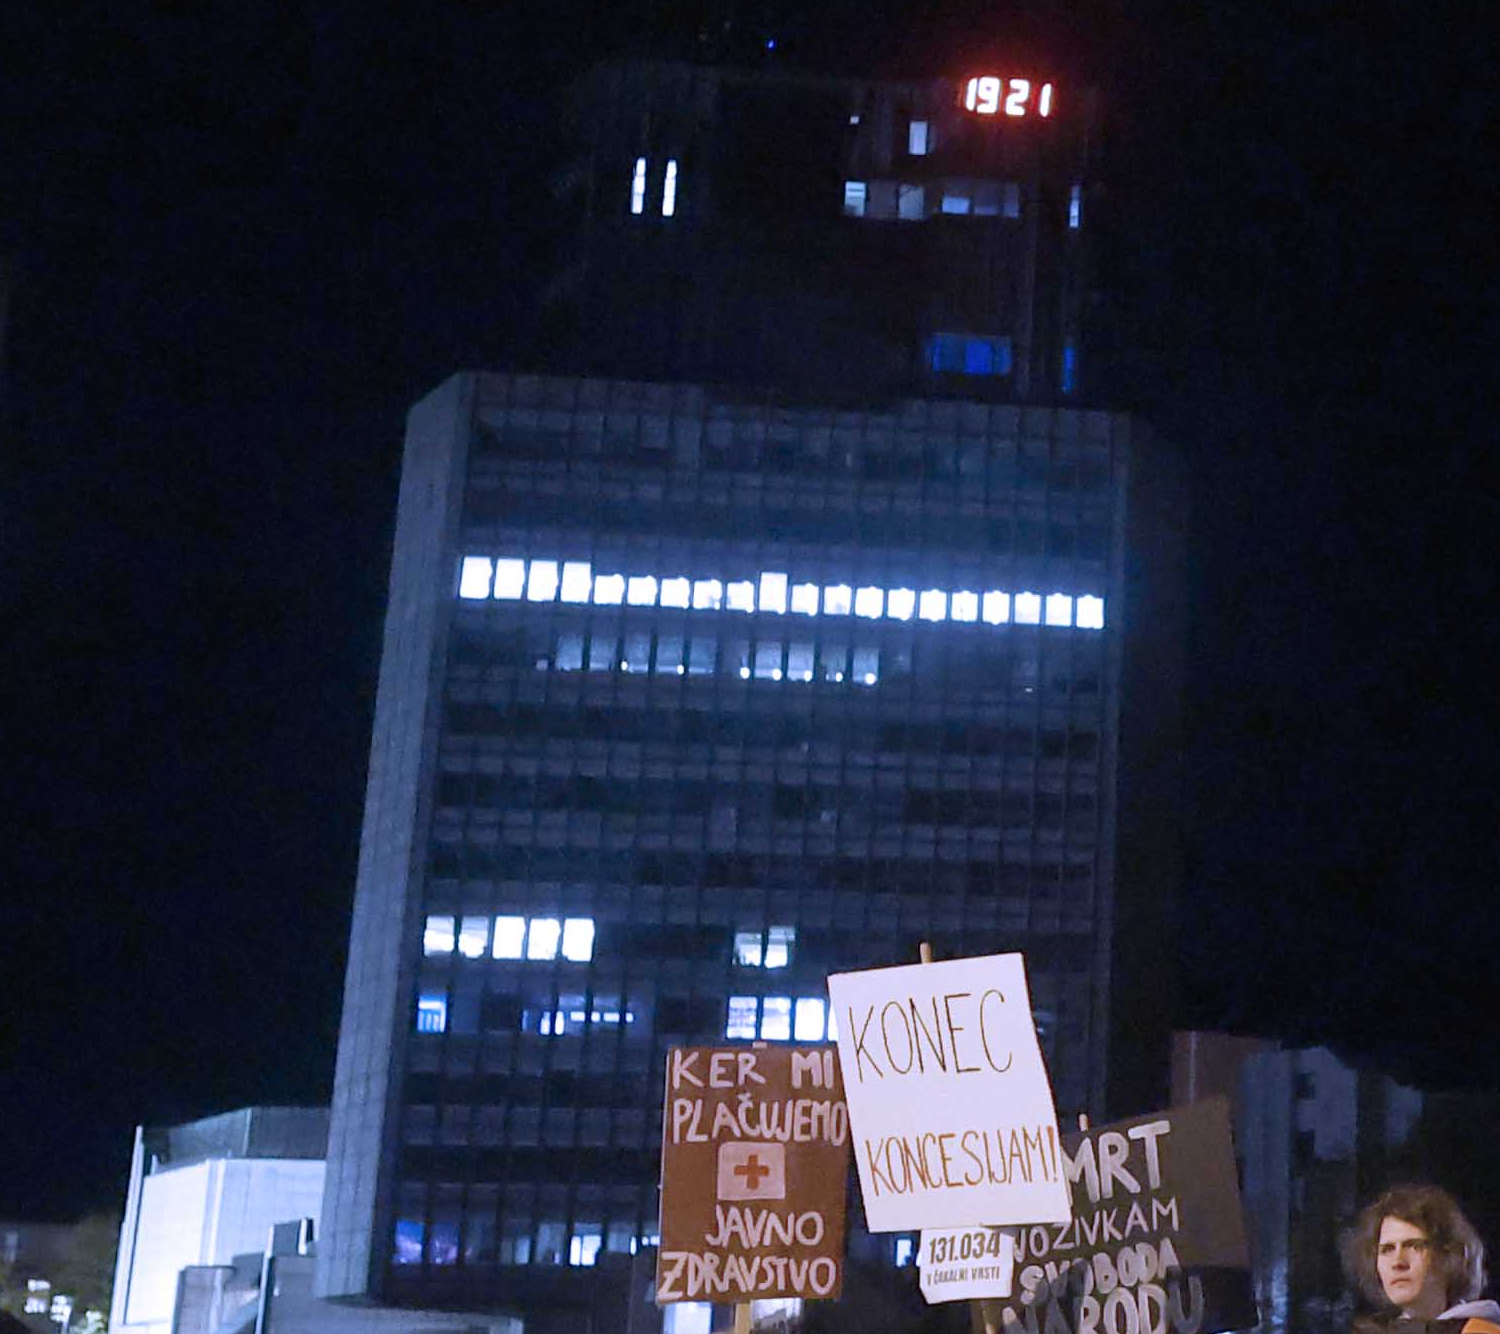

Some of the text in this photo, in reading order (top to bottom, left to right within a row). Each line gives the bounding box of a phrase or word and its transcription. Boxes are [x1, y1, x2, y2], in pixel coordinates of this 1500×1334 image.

[849, 989, 1012, 1083] KONEC
[673, 1049, 833, 1090] KER MI
[673, 1093, 847, 1146] PLAČUJEMO
[866, 1125, 1058, 1196] KONCESIJAM!
[1062, 1120, 1170, 1203] MRT
[706, 1204, 824, 1249] JAVNO
[930, 1232, 1000, 1264] 131.034
[658, 1252, 836, 1300] ZDRAVSTVO
